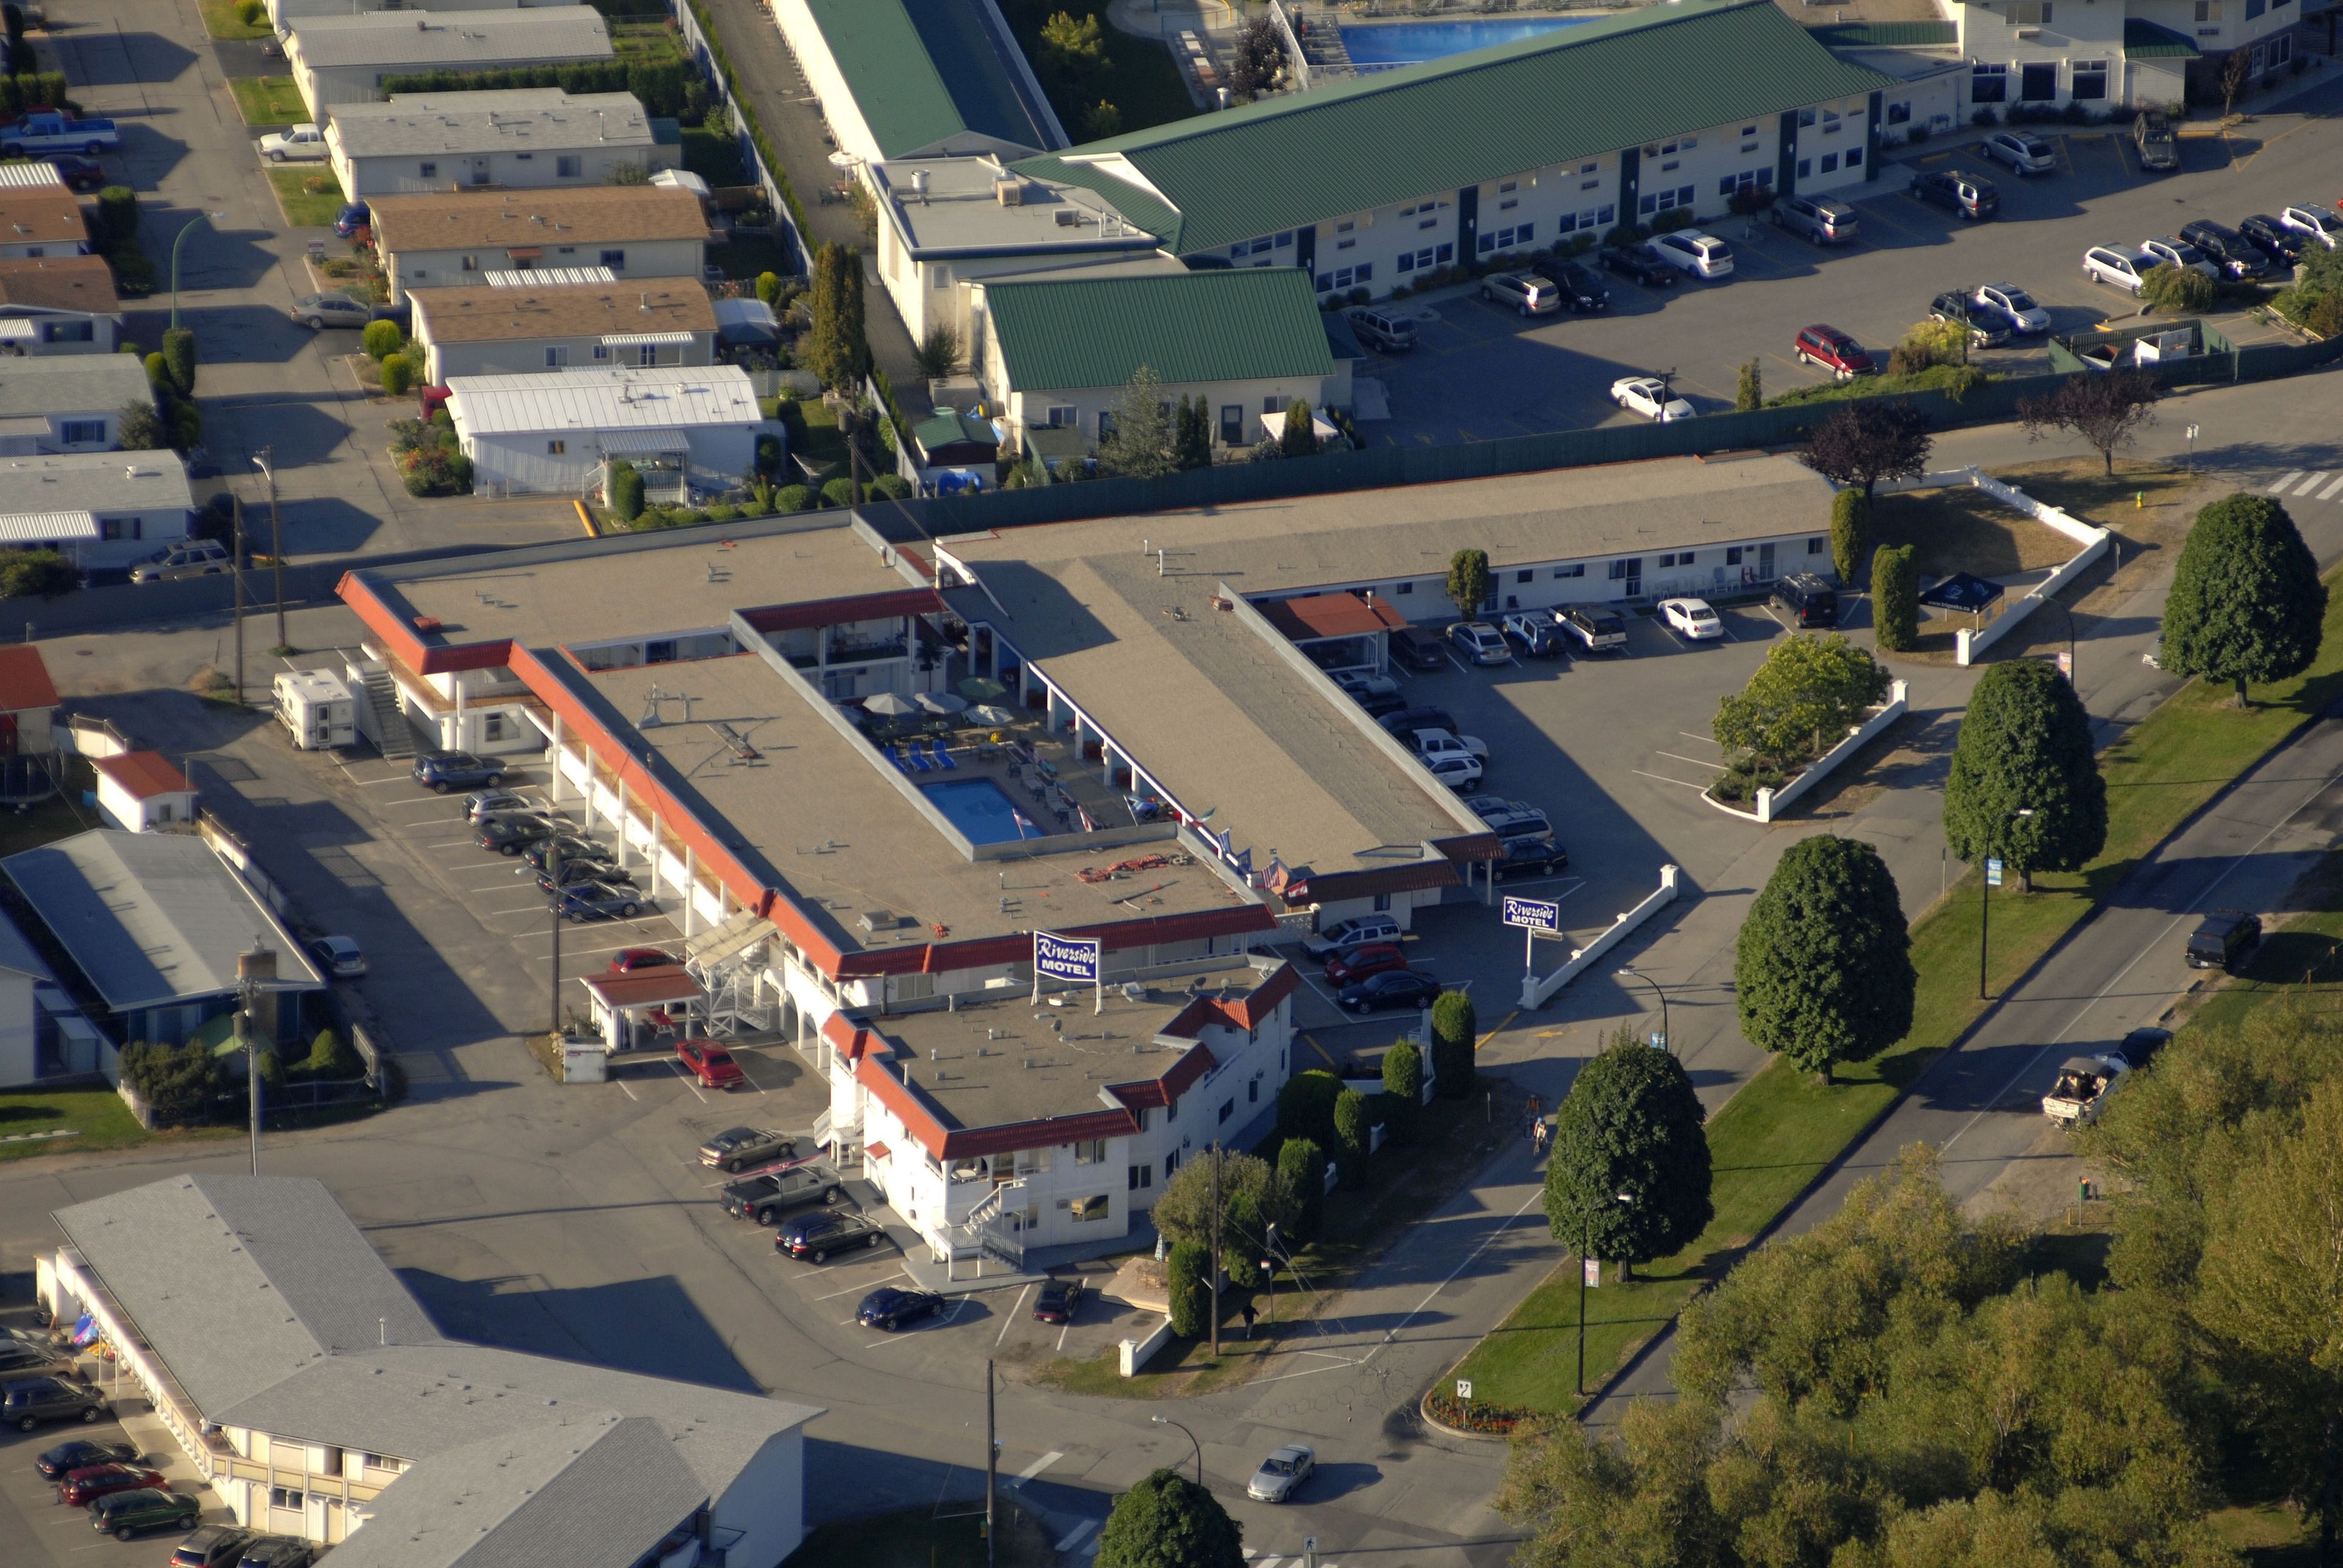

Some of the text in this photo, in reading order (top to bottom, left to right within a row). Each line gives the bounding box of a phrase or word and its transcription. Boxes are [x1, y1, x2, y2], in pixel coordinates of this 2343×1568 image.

[1506, 900, 1553, 919] Riverside
[1511, 915, 1550, 927] MOTEL
[1038, 938, 1095, 964] Riverside
[1042, 959, 1091, 976] MOTEL
